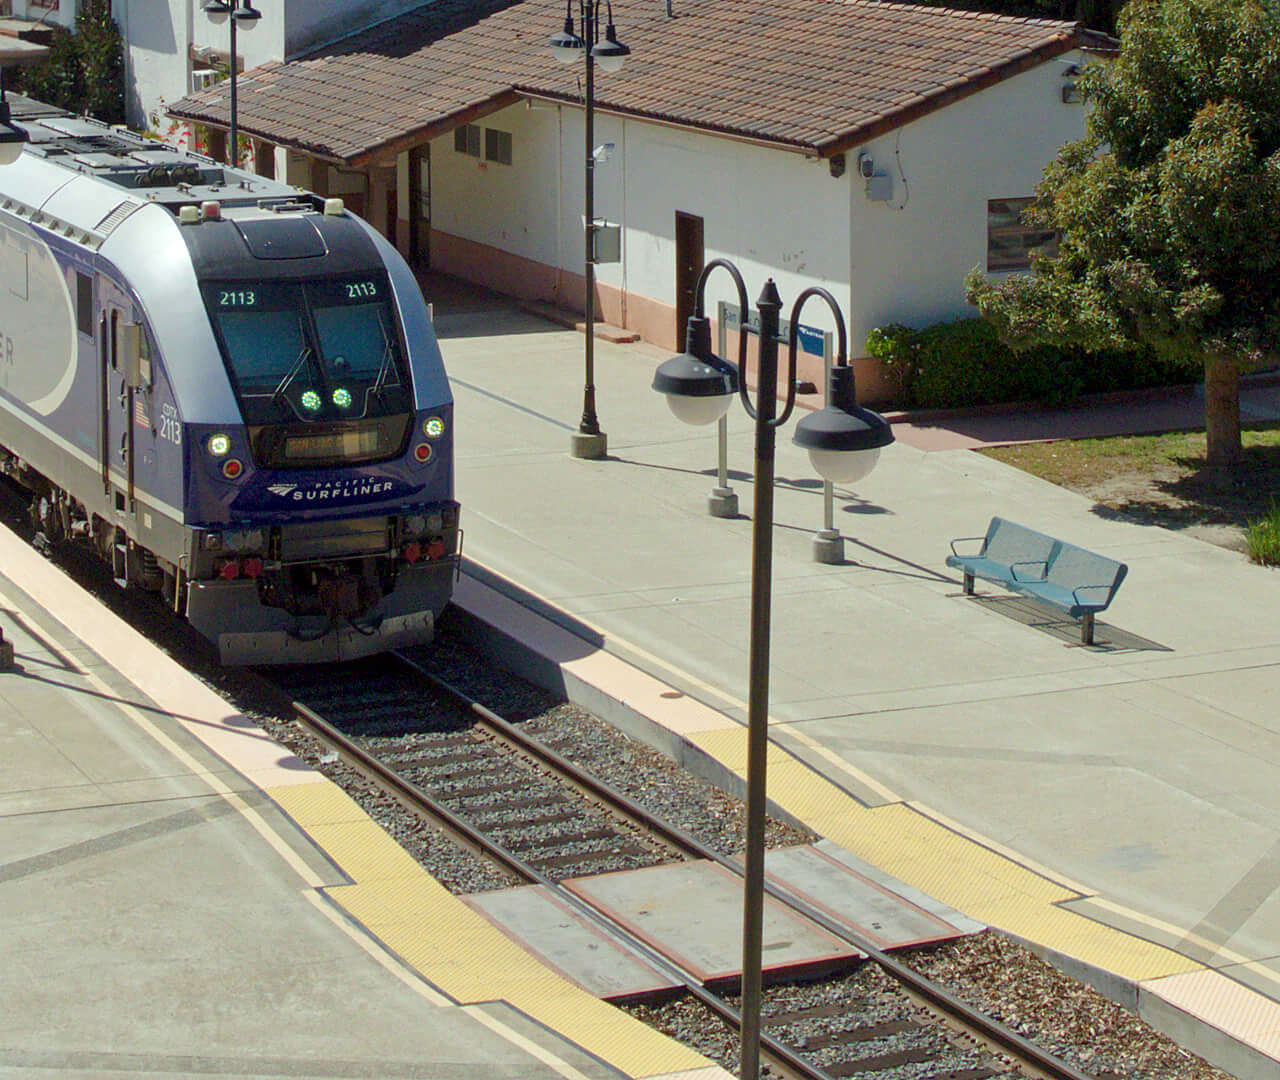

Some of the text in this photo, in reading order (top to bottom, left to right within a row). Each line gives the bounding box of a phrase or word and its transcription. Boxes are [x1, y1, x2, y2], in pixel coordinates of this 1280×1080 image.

[220, 291, 255, 305] 2113
[346, 282, 377, 298] 2113
[160, 414, 181, 445] 2113
[315, 476, 375, 488] PACIFIC
[292, 482, 393, 500] SURFLINER
